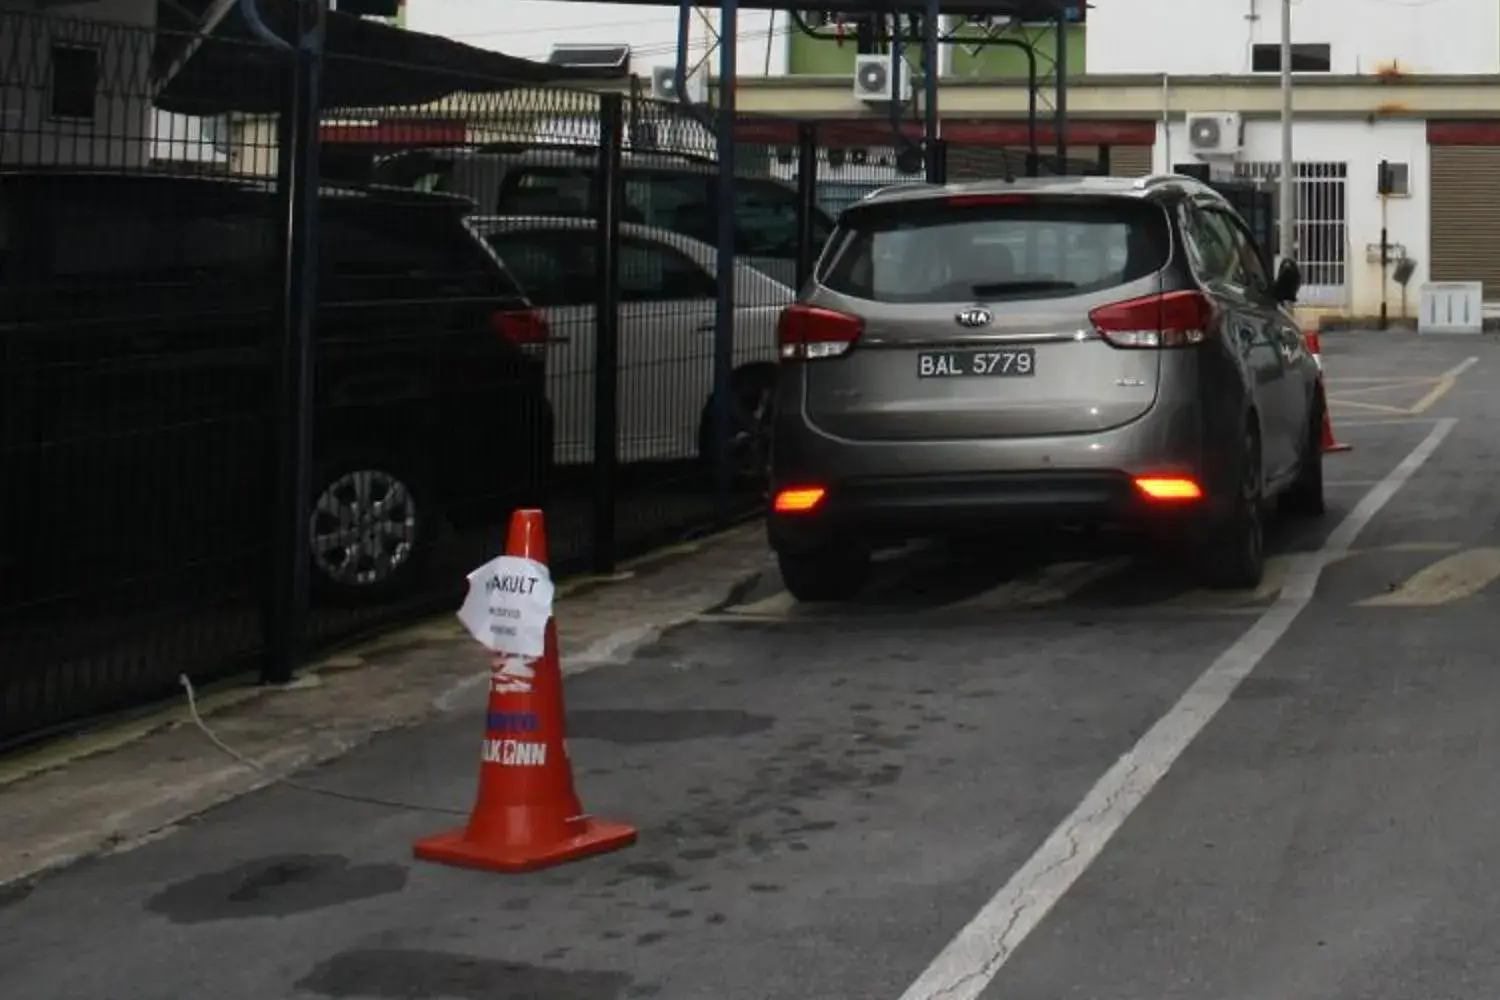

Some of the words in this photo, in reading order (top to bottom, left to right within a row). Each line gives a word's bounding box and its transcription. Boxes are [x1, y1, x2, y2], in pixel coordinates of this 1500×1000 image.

[960, 310, 988, 323] KIA
[920, 354, 963, 376] BAL
[972, 352, 1032, 374] 5779
